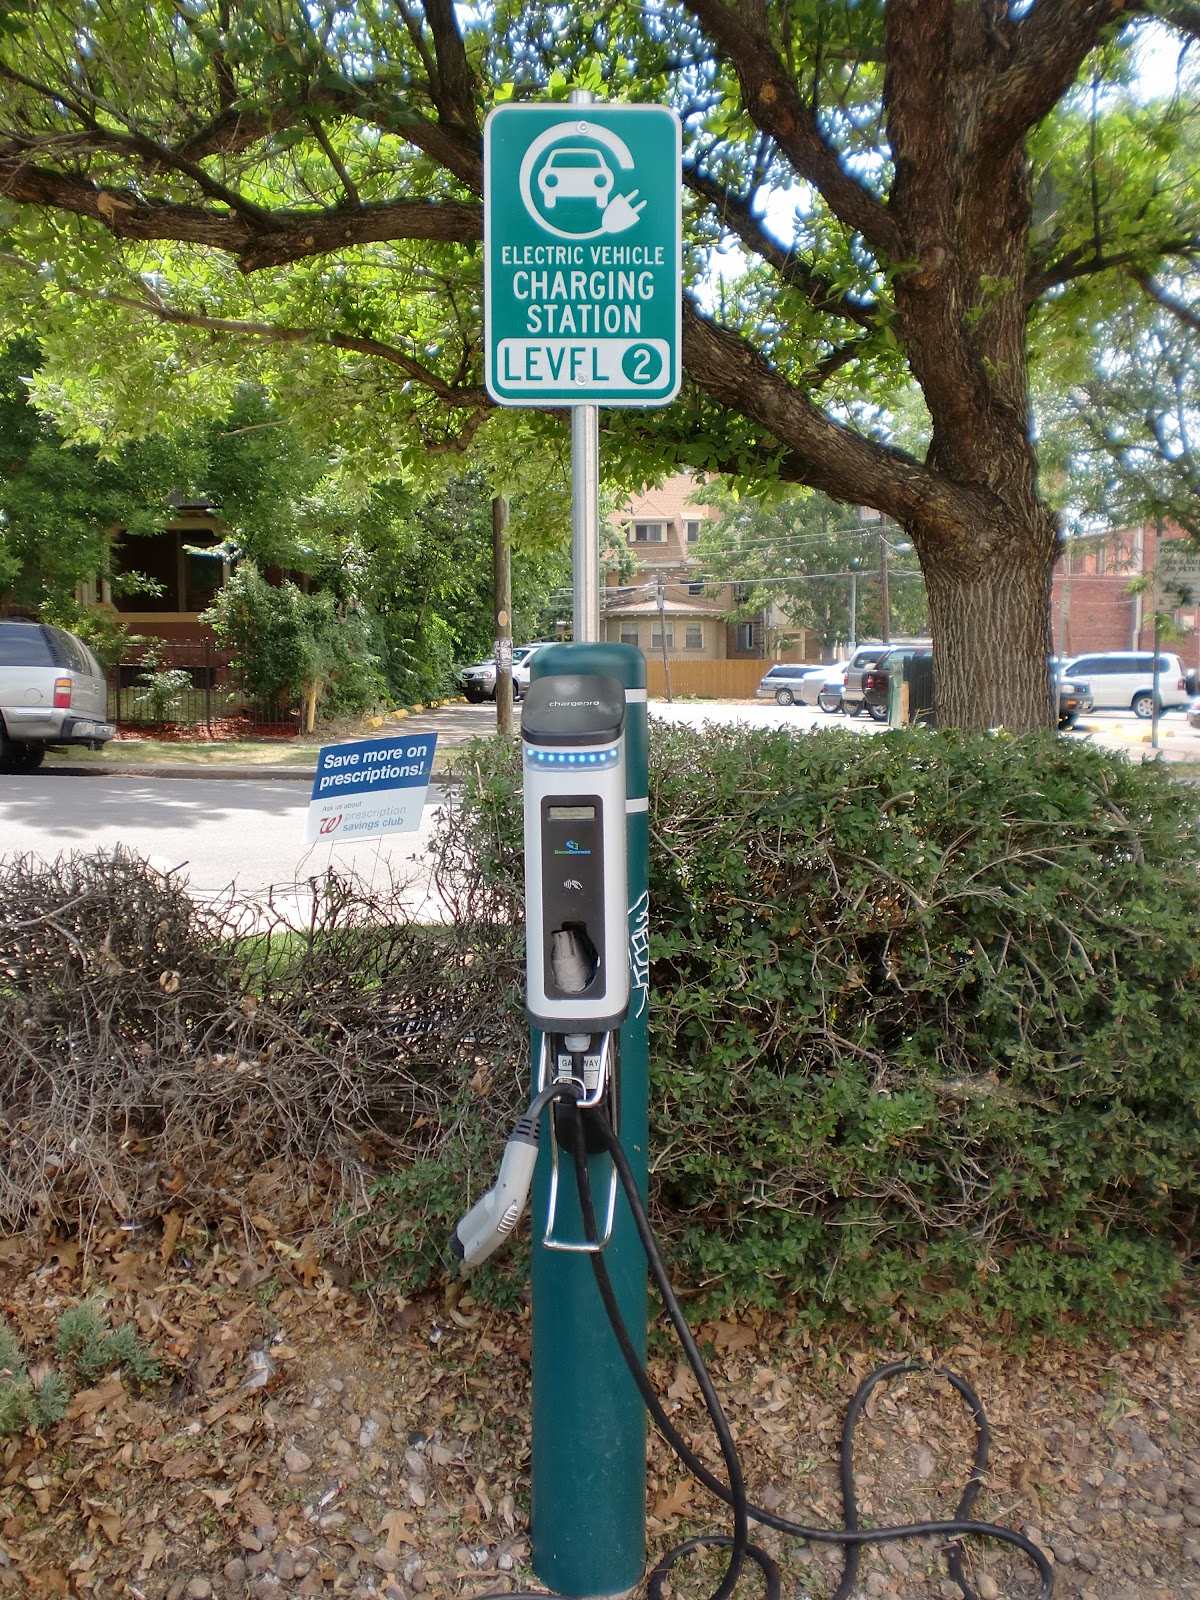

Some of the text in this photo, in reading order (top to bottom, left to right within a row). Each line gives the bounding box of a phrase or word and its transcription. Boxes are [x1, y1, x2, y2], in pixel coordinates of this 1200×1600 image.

[501, 245, 665, 265] ELECTRIC VEHICLE
[513, 270, 654, 300] CHARGING
[526, 304, 641, 334] STATION
[504, 346, 651, 381] LEVEL 2
[323, 745, 428, 769] Save more on
[319, 761, 425, 791] prescriptions!
[322, 805, 334, 813] Ask
[344, 801, 362, 809] about
[344, 805, 407, 822] prescription
[342, 816, 404, 832] savings club
